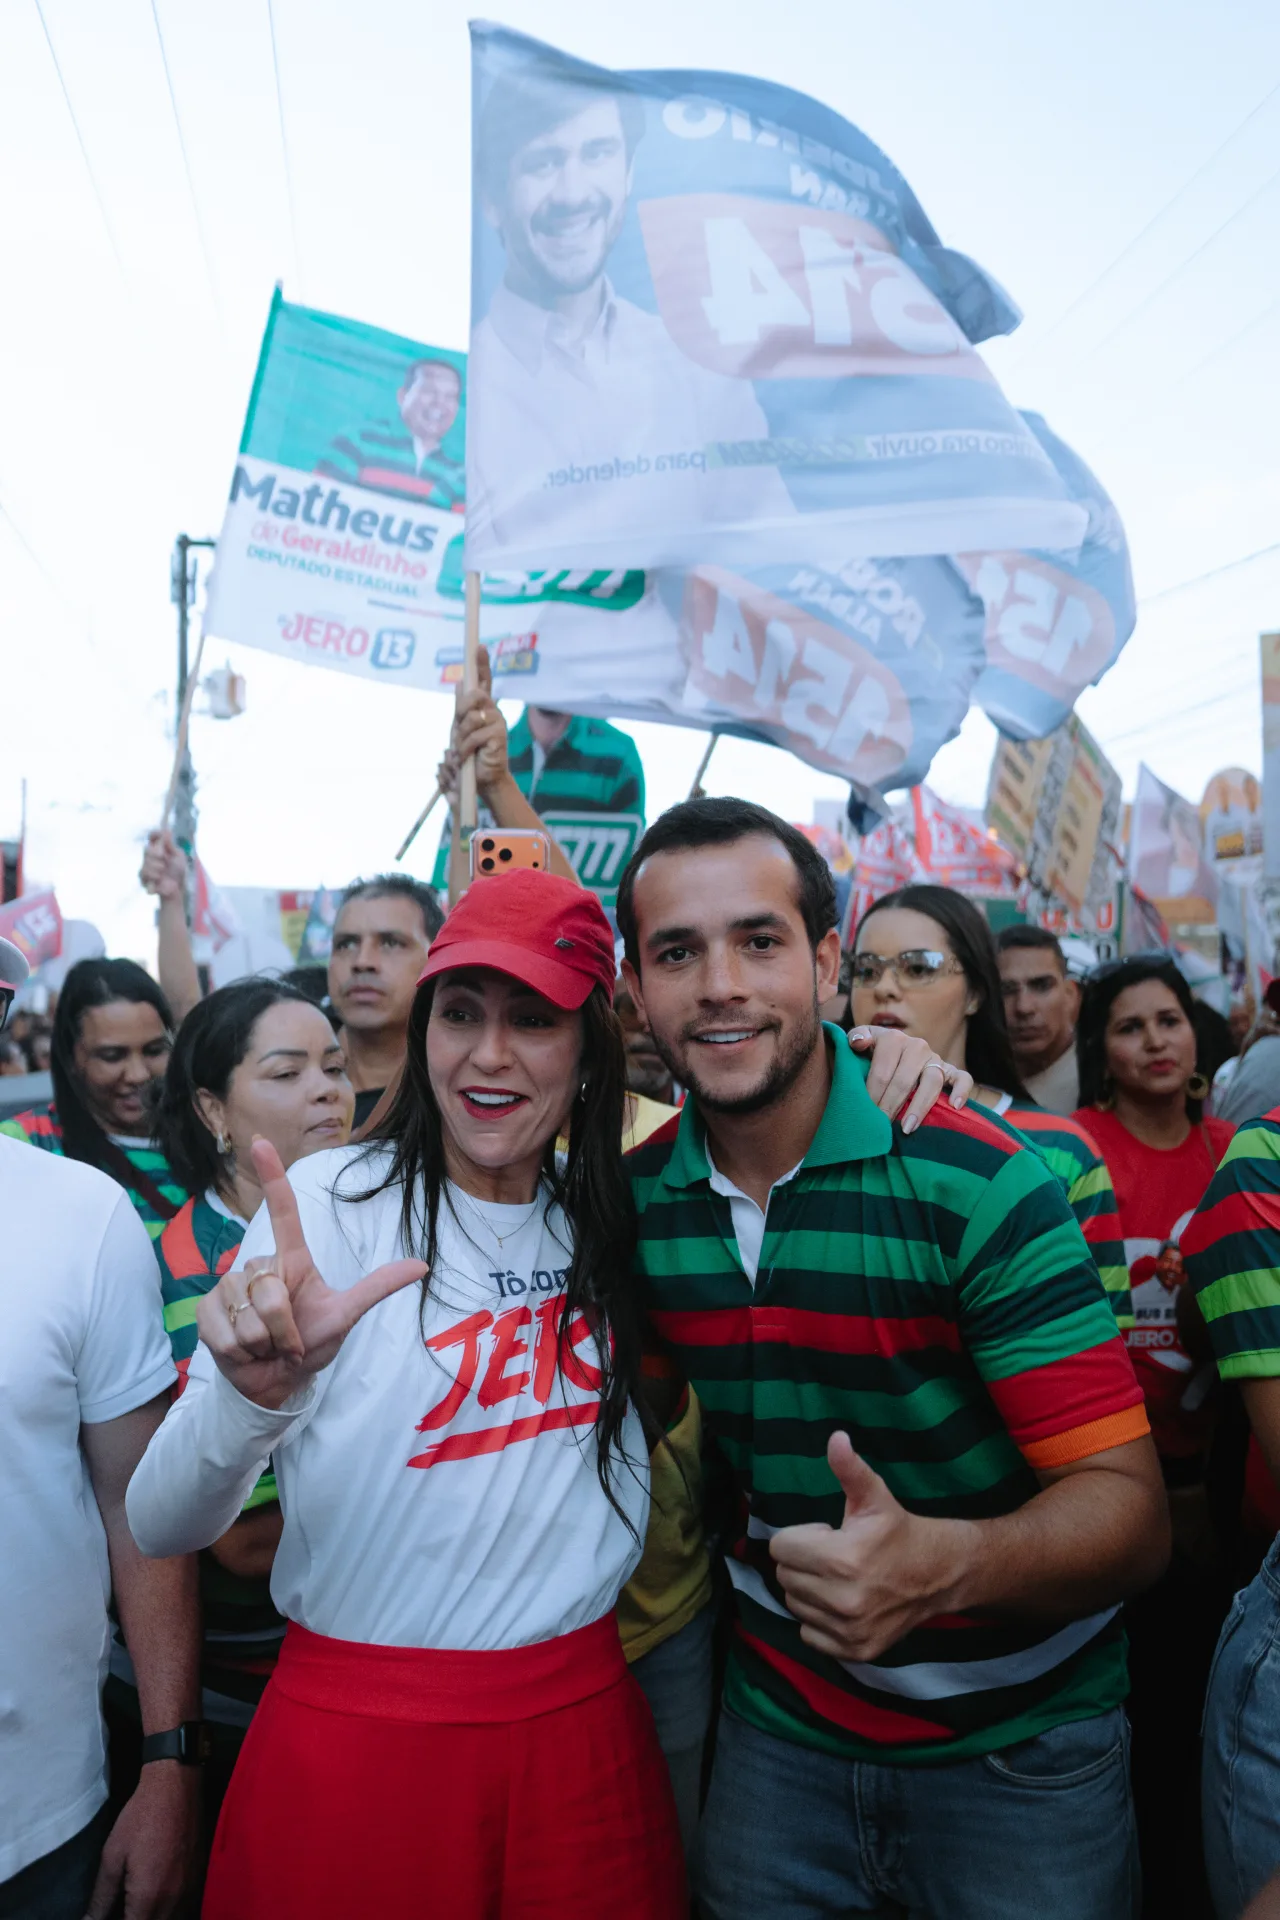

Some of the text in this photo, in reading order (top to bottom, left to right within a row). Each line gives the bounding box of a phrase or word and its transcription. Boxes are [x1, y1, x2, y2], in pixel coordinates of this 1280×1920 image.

[229, 465, 439, 552] Matheus
[246, 543, 332, 578] DEPUTADO
[333, 566, 419, 598] ESTADUAL
[250, 519, 428, 580] de Geraldinho
[281, 612, 370, 658] JERO
[377, 630, 413, 667] 13
[488, 1269, 527, 1298] Tô
[1124, 1328, 1175, 1348] JERO
